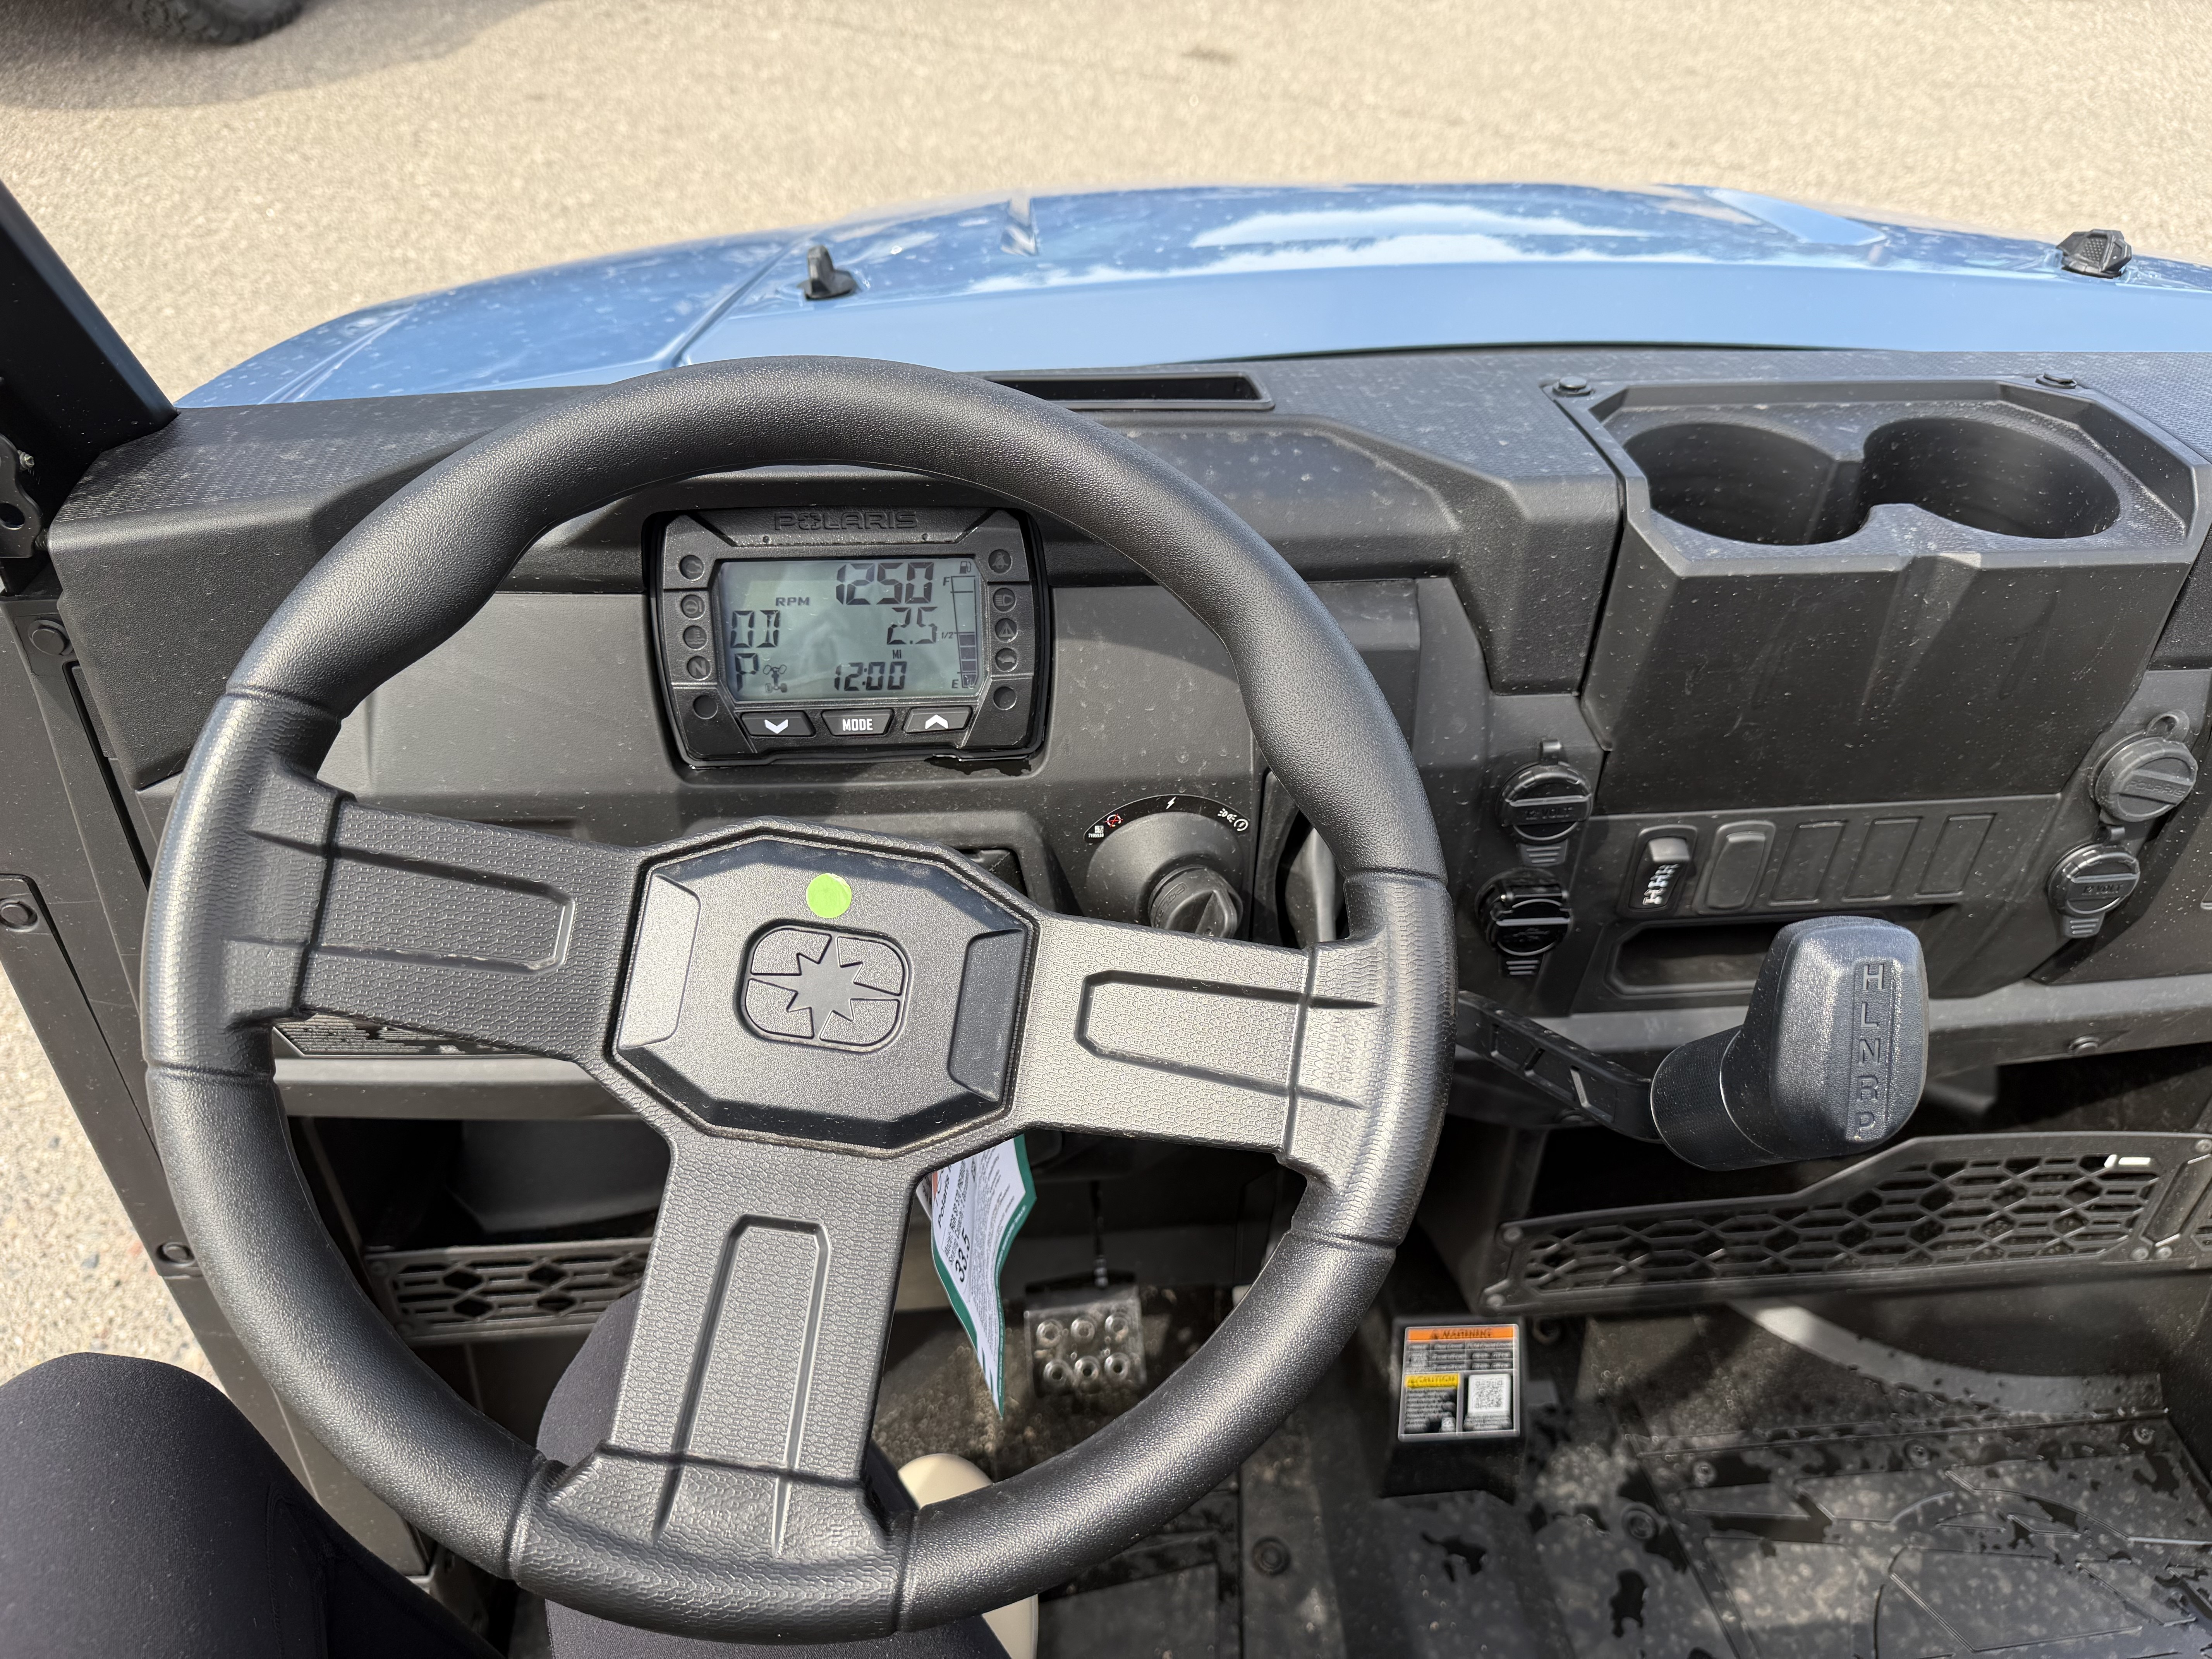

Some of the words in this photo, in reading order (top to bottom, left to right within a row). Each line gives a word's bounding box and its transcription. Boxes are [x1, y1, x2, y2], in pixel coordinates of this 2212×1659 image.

[775, 511, 918, 531] POLARIS
[836, 562, 934, 605] 1250
[943, 577, 950, 586] F
[775, 597, 810, 606] RPM
[887, 606, 938, 645] 2.5
[892, 649, 902, 659] MI
[735, 653, 759, 692] P
[835, 661, 907, 692] 12:00
[951, 679, 959, 689] E
[842, 718, 873, 731] MODE
[2124, 780, 2186, 798] POLARIS
[1862, 963, 1885, 991] H
[1860, 1003, 1879, 1029] L
[1859, 1039, 1881, 1066] N
[1858, 1075, 1879, 1102] R
[1855, 1112, 1875, 1139] P
[938, 1174, 950, 1228] Polaris
[955, 1227, 970, 1283] 33.5
